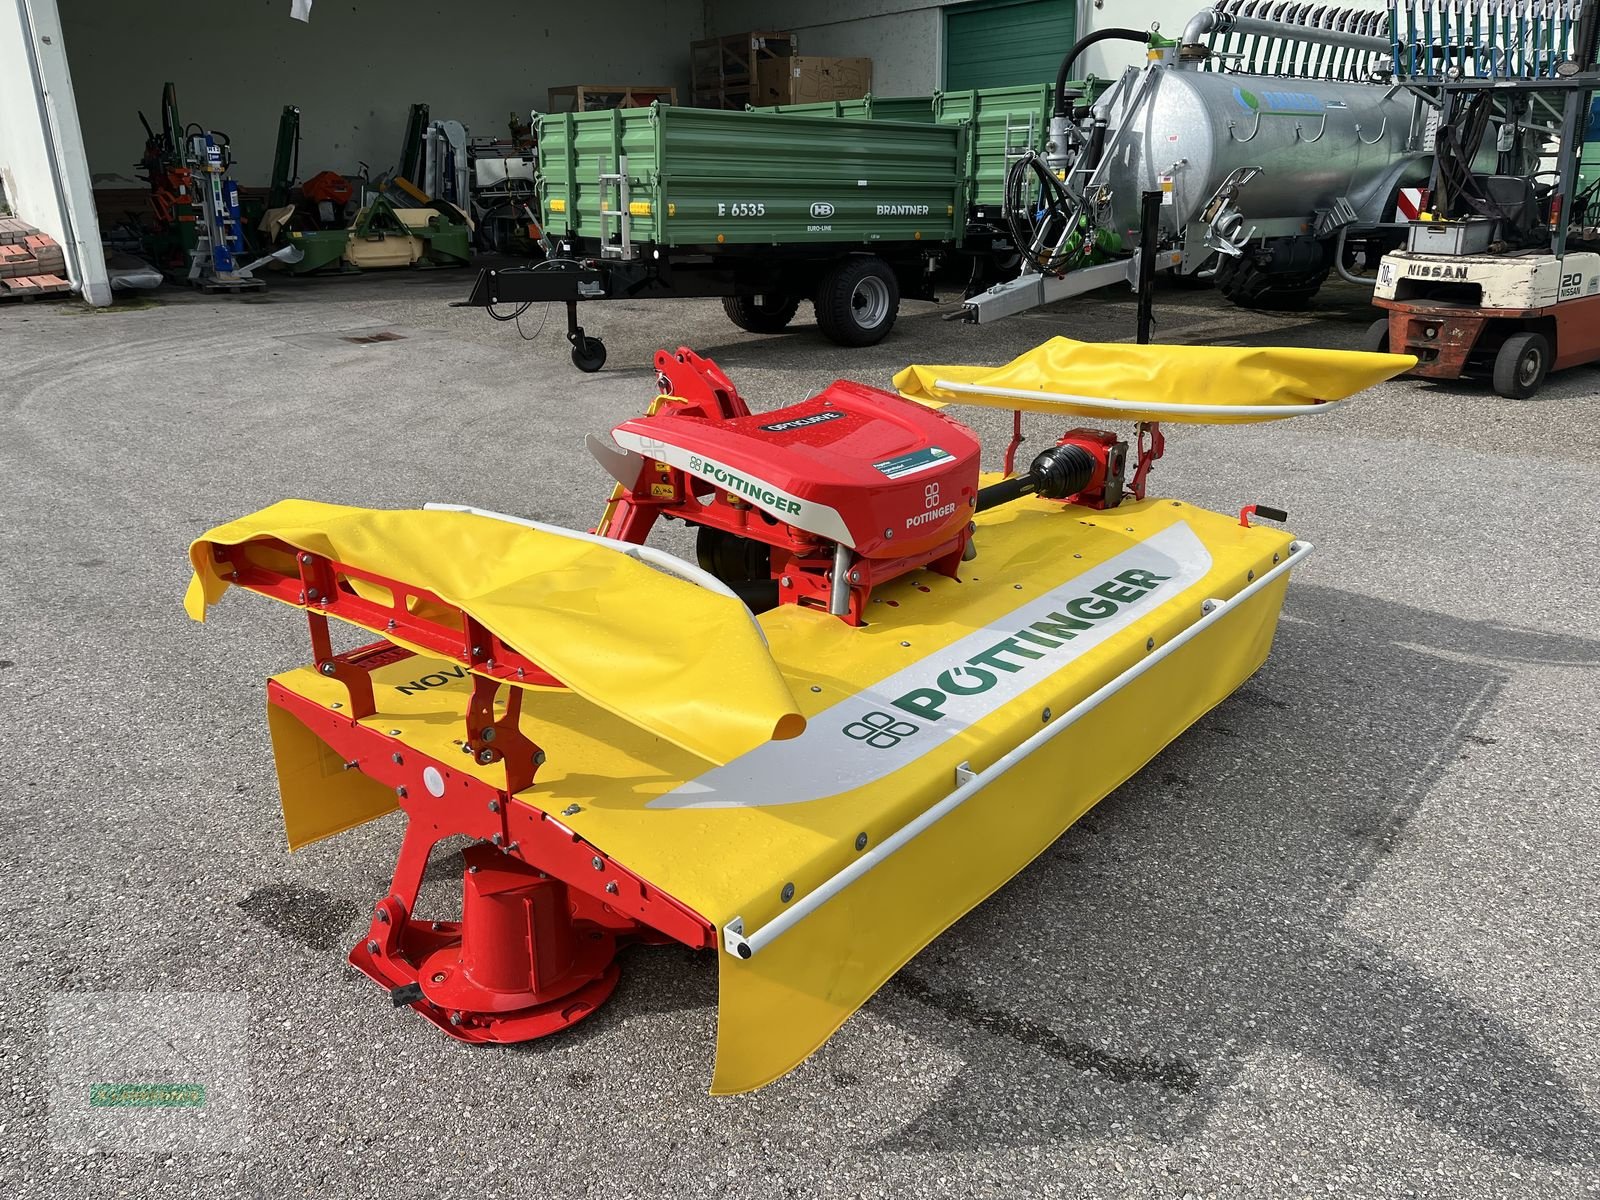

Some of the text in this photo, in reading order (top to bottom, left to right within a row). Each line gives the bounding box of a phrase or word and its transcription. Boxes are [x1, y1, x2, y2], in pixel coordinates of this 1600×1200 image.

[718, 203, 765, 217] E 6535
[876, 205, 929, 216] BRANTNER
[1407, 264, 1469, 279] NISSAN
[1562, 272, 1583, 288] 20
[1561, 287, 1582, 298] NISSAN
[767, 412, 840, 431] OPTICURVE
[394, 665, 471, 696] NOV
